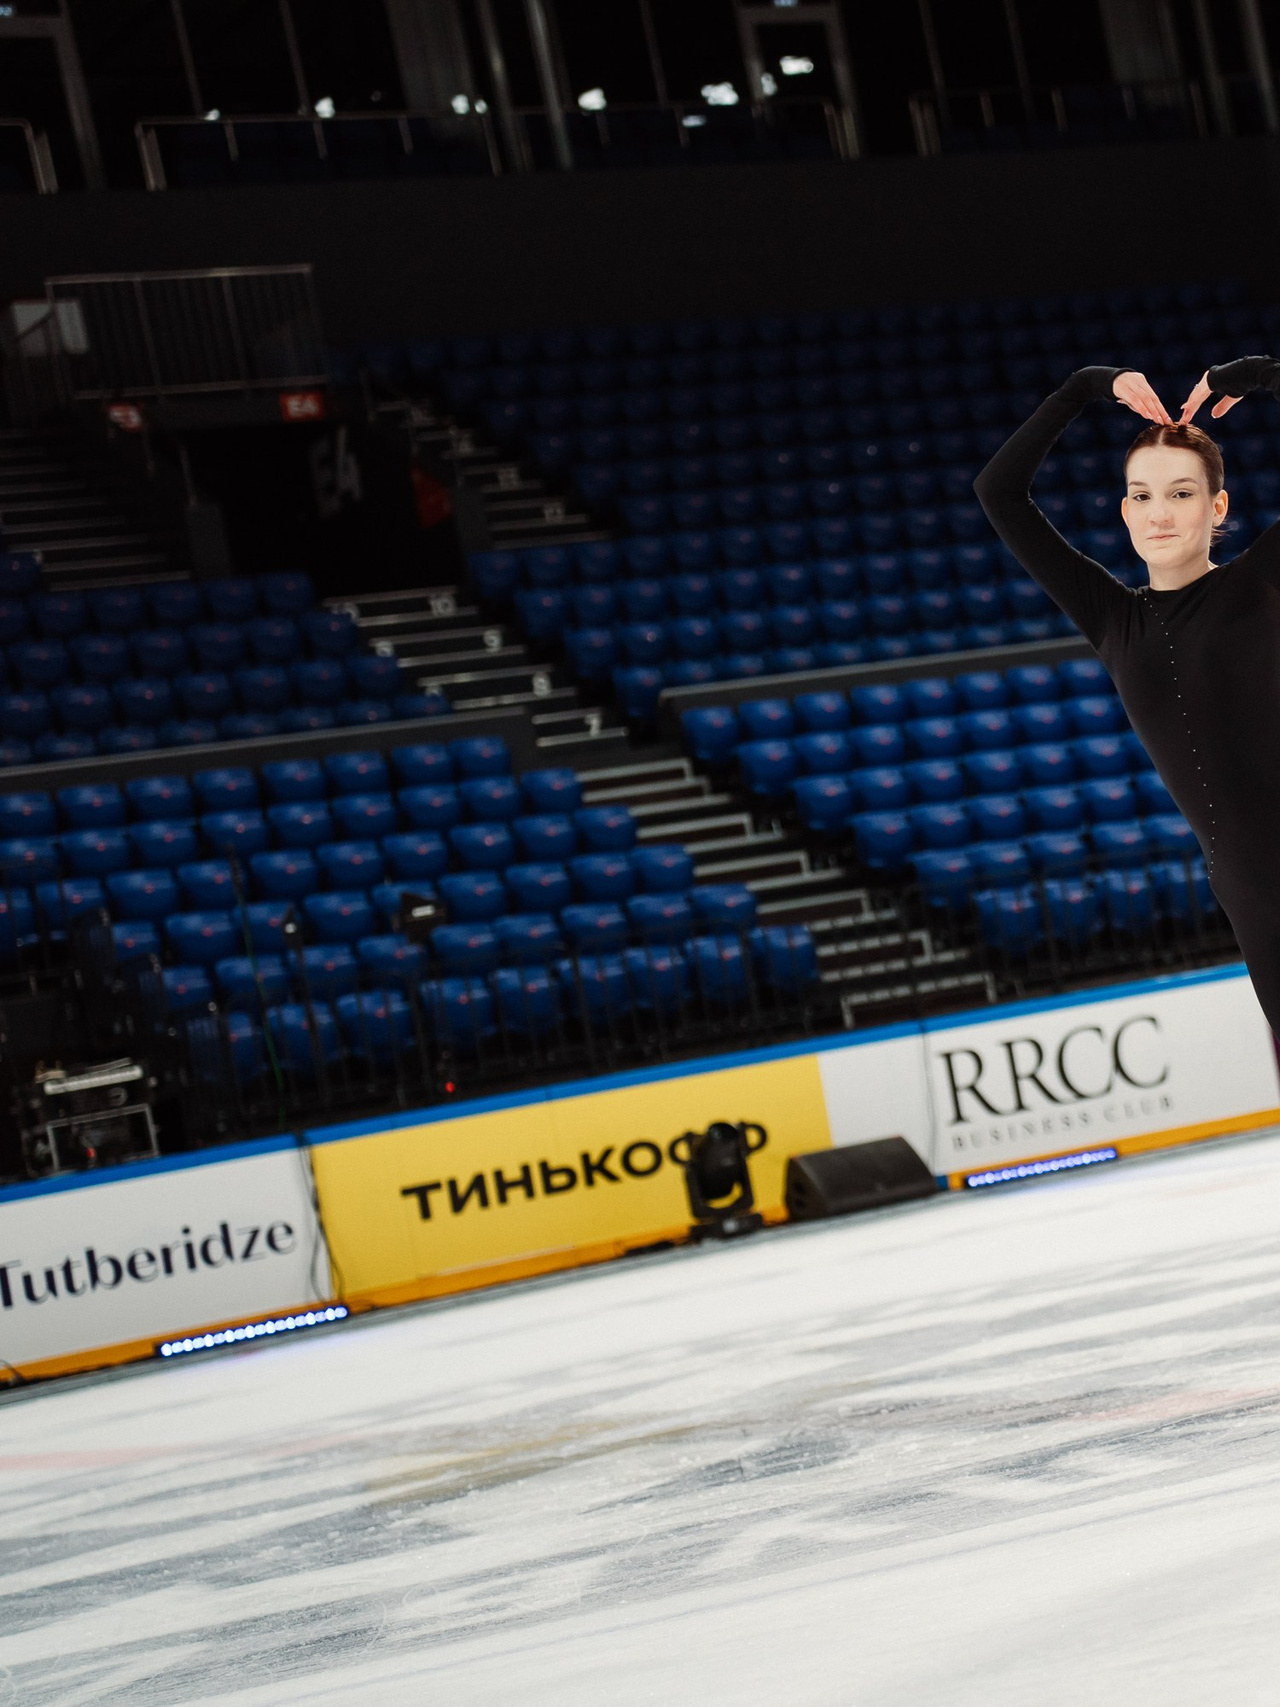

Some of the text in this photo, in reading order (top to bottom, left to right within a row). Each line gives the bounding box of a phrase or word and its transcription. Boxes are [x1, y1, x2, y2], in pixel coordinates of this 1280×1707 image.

[940, 1014, 1170, 1124] RRCC
[953, 1096, 1173, 1151] BUSINESS CLUB
[0, 1220, 298, 1310] Tutberidze
